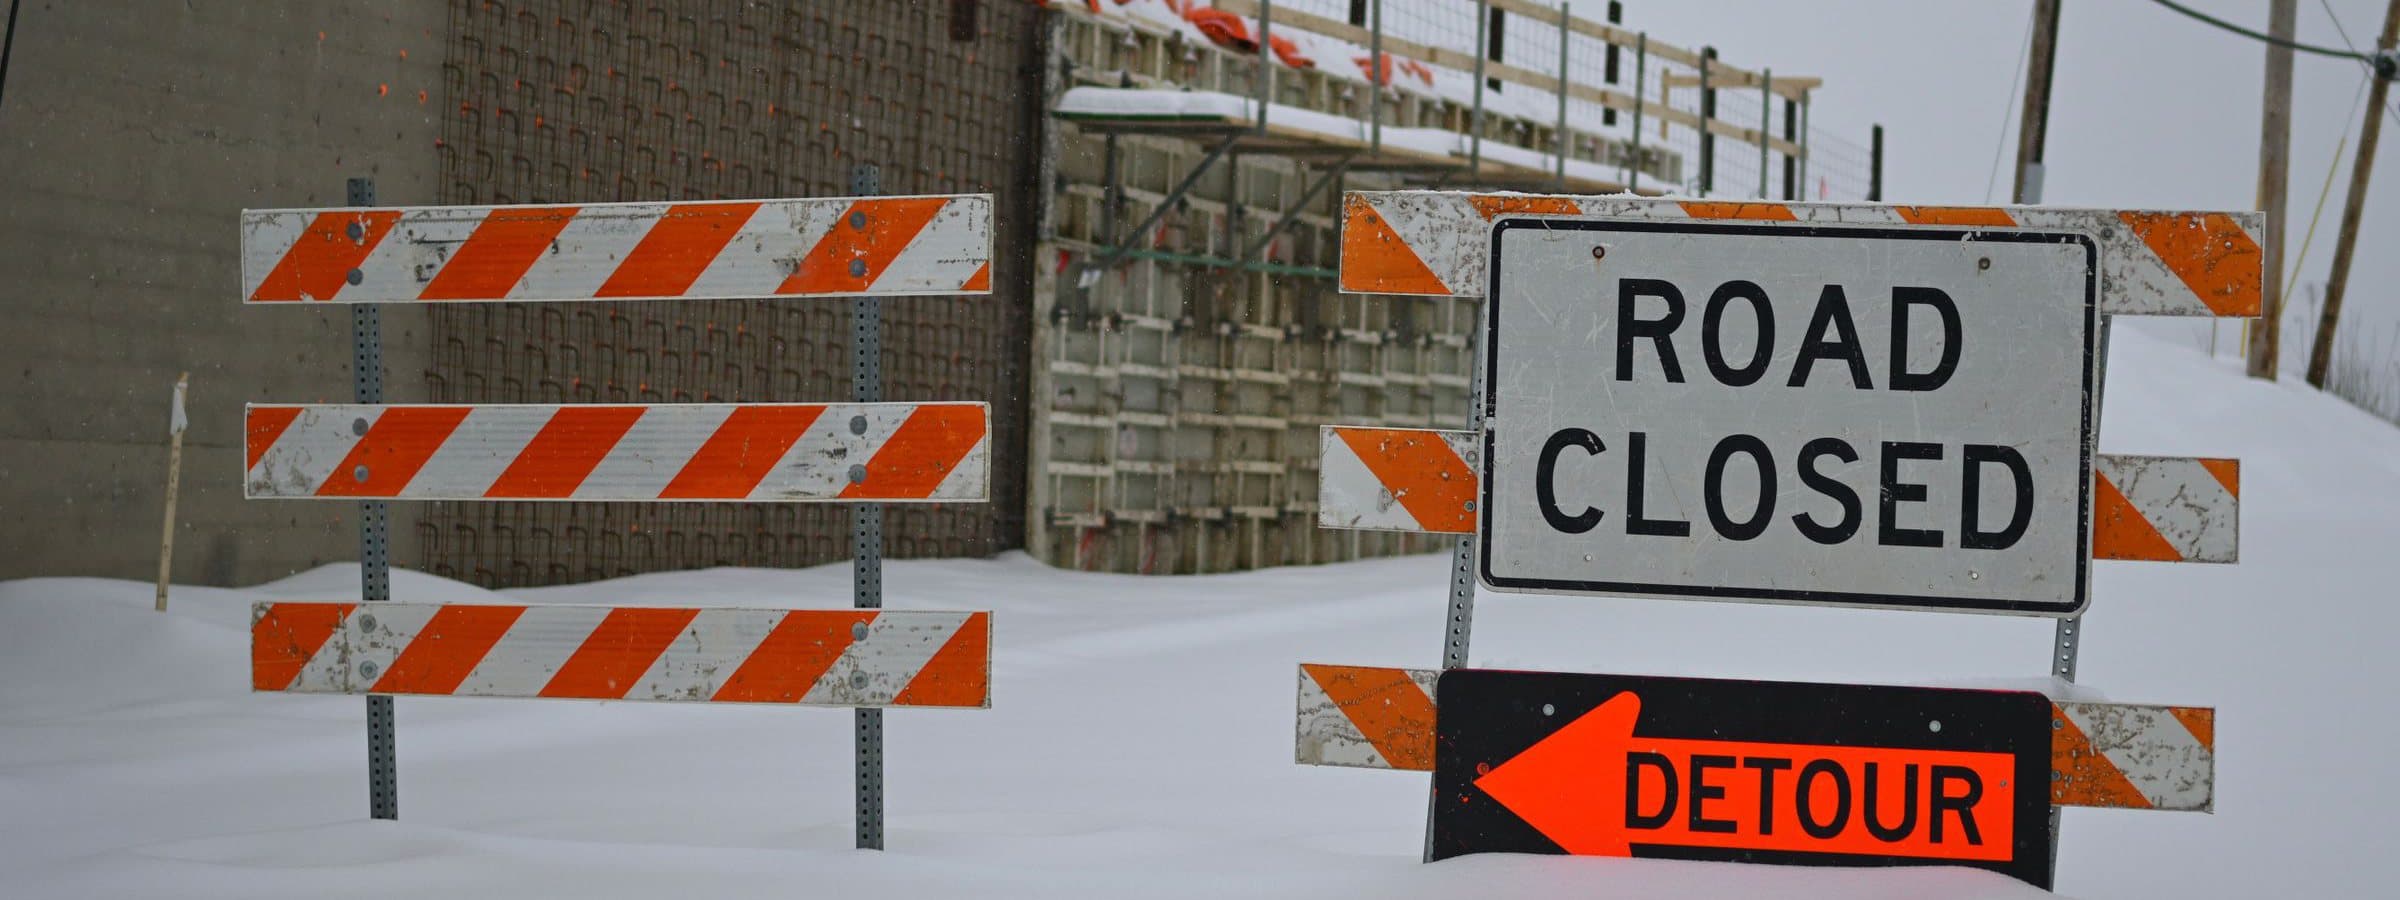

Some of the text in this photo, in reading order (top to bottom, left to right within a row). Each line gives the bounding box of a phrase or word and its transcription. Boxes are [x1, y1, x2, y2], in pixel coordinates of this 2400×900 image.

[1615, 278, 1963, 392] ROAD
[1535, 427, 2034, 551] CLOSED
[1625, 751, 1984, 846] DETOUR
